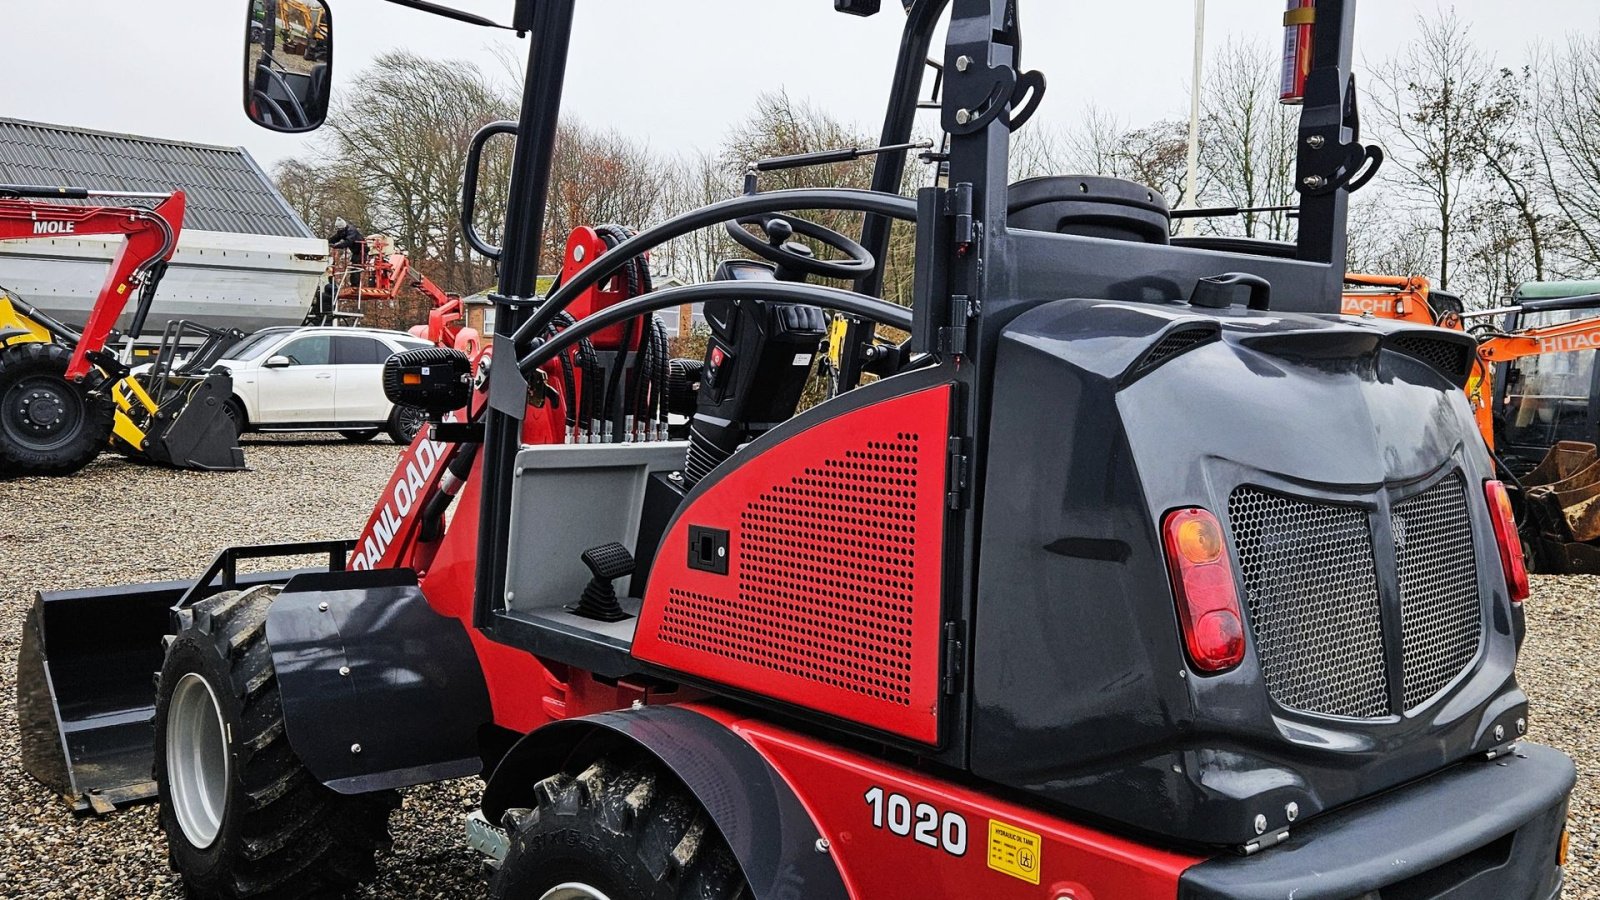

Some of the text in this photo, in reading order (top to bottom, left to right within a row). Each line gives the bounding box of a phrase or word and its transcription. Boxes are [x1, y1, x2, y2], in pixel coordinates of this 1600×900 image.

[33, 221, 75, 234] MOLE
[864, 787, 968, 857] 1020
[995, 829, 1016, 841] HYDRAULIC
[1023, 837, 1034, 846] TANK
